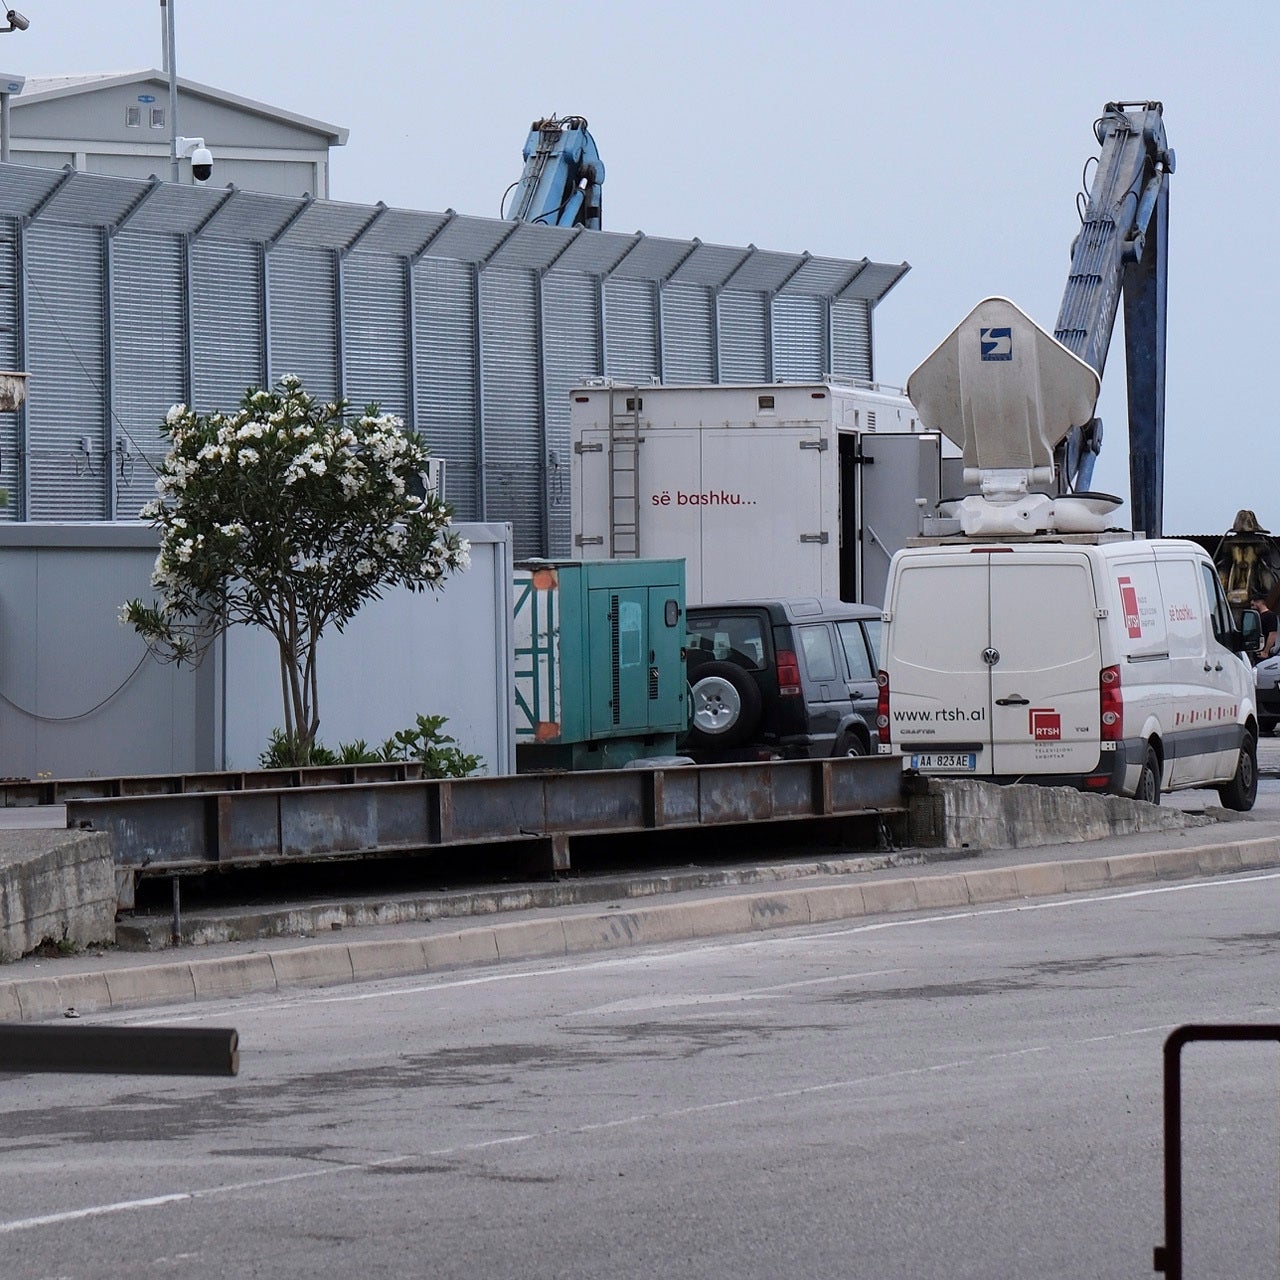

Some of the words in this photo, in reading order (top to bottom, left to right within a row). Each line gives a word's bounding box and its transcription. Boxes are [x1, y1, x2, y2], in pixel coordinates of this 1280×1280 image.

[652, 491, 671, 505] së
[677, 490, 756, 505] bashku...
[894, 707, 985, 721] www.rtsh.al
[1036, 727, 1060, 736] RTSH
[920, 756, 932, 766] AA
